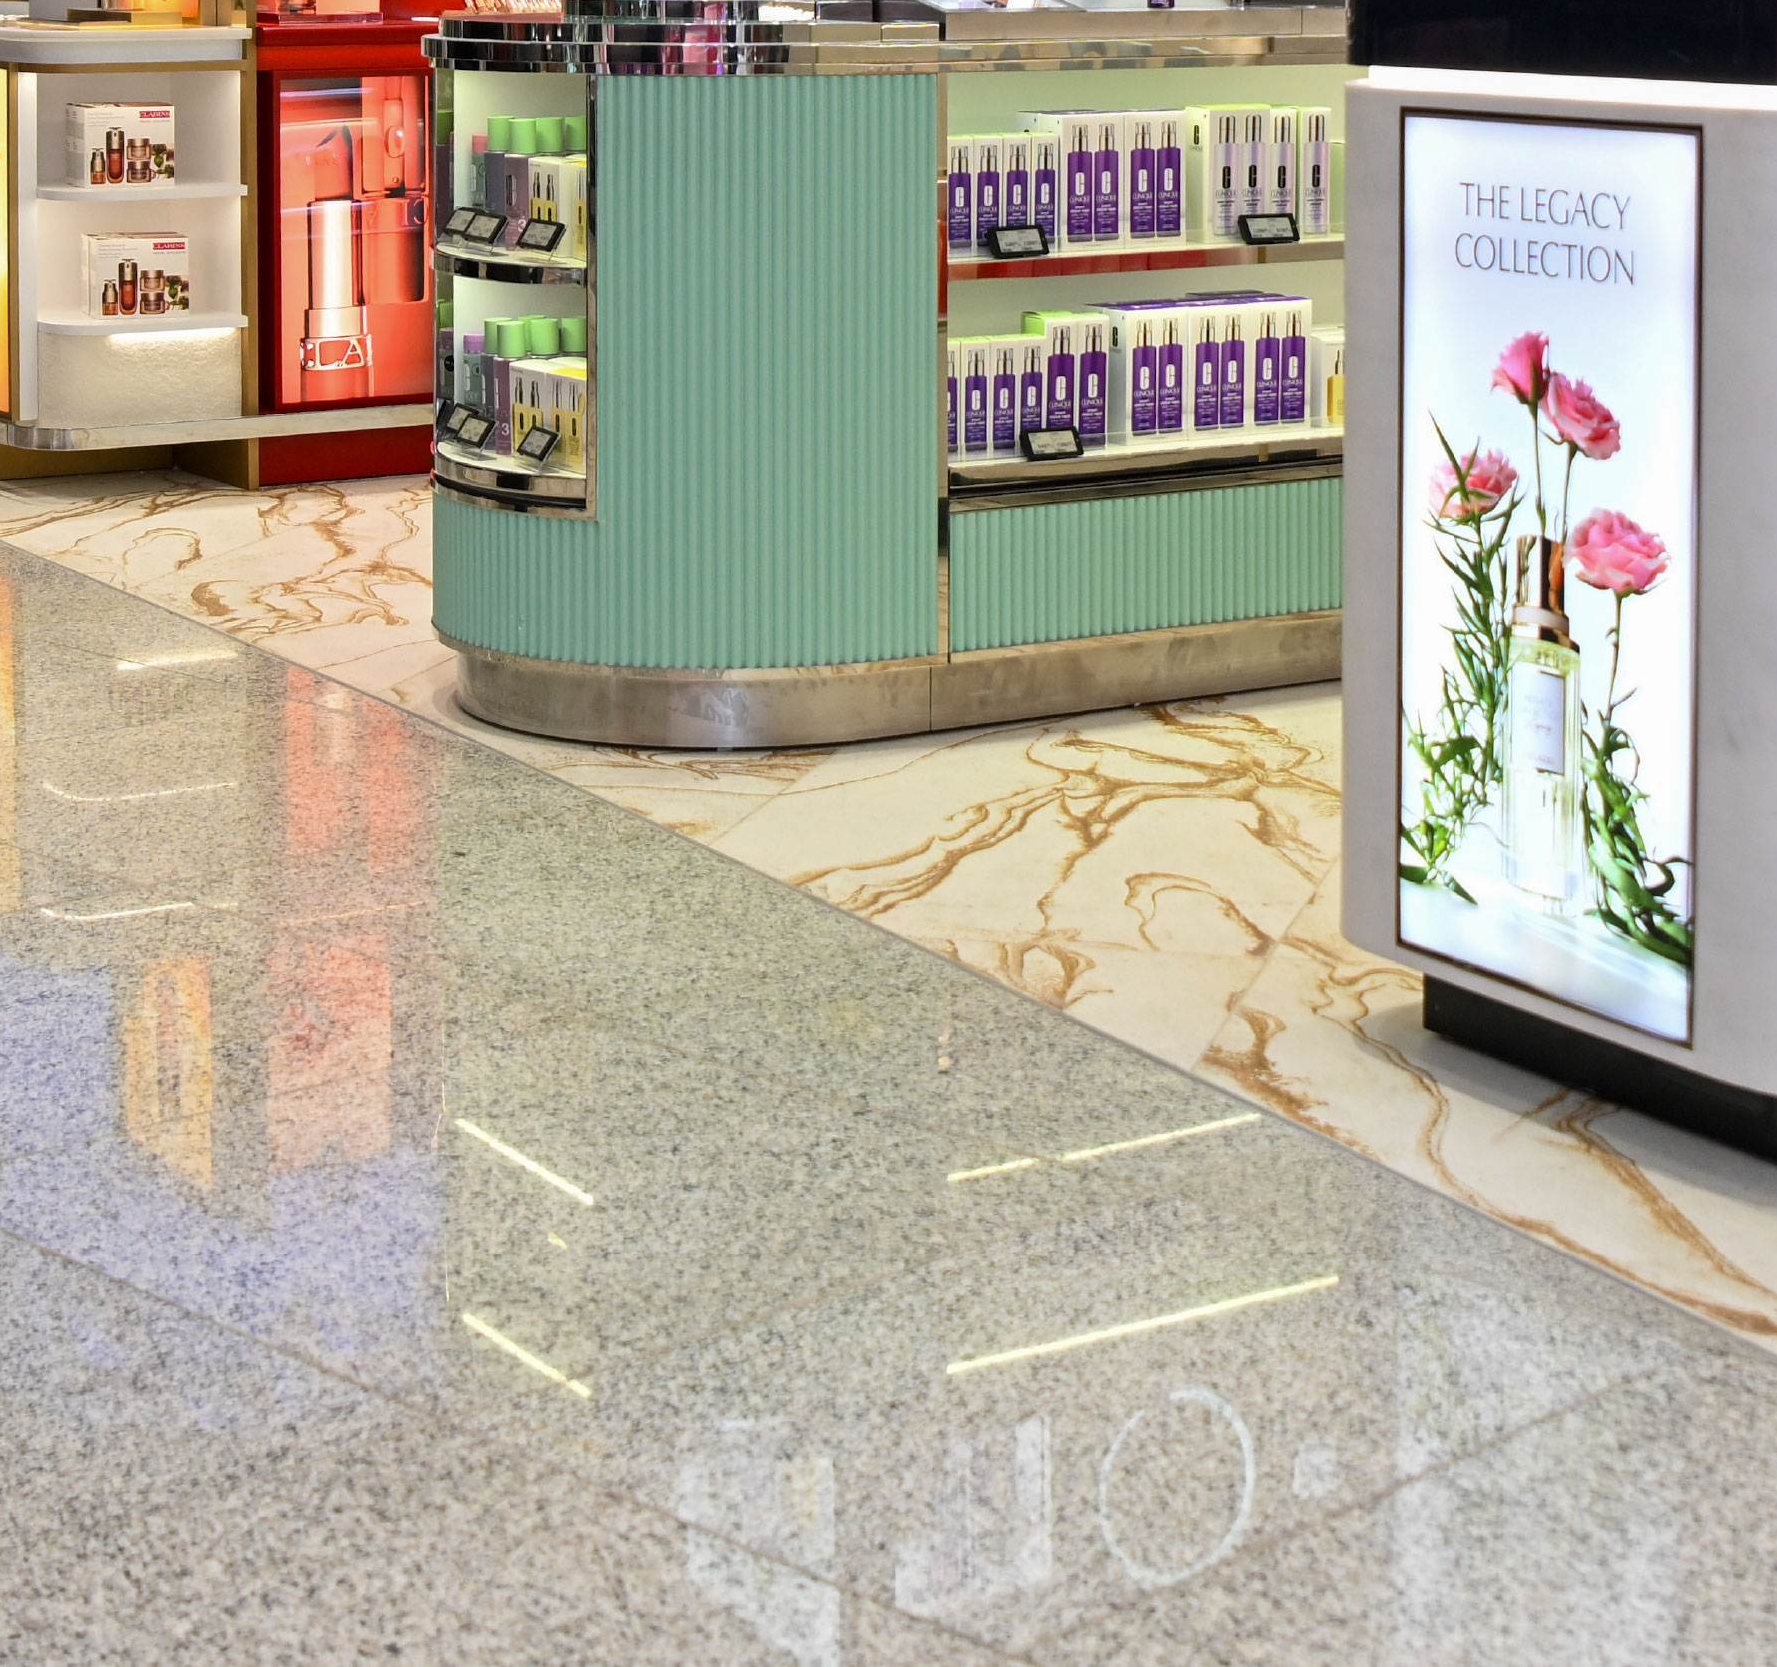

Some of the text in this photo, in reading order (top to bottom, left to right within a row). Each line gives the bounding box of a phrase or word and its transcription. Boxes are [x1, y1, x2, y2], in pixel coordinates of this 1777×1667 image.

[140, 110, 171, 119] CLARINS
[1459, 182, 1631, 230] THE LEGACY
[153, 242, 186, 251] CLARINS
[1455, 232, 1637, 287] COLLECTION
[501, 423, 510, 435] 3
